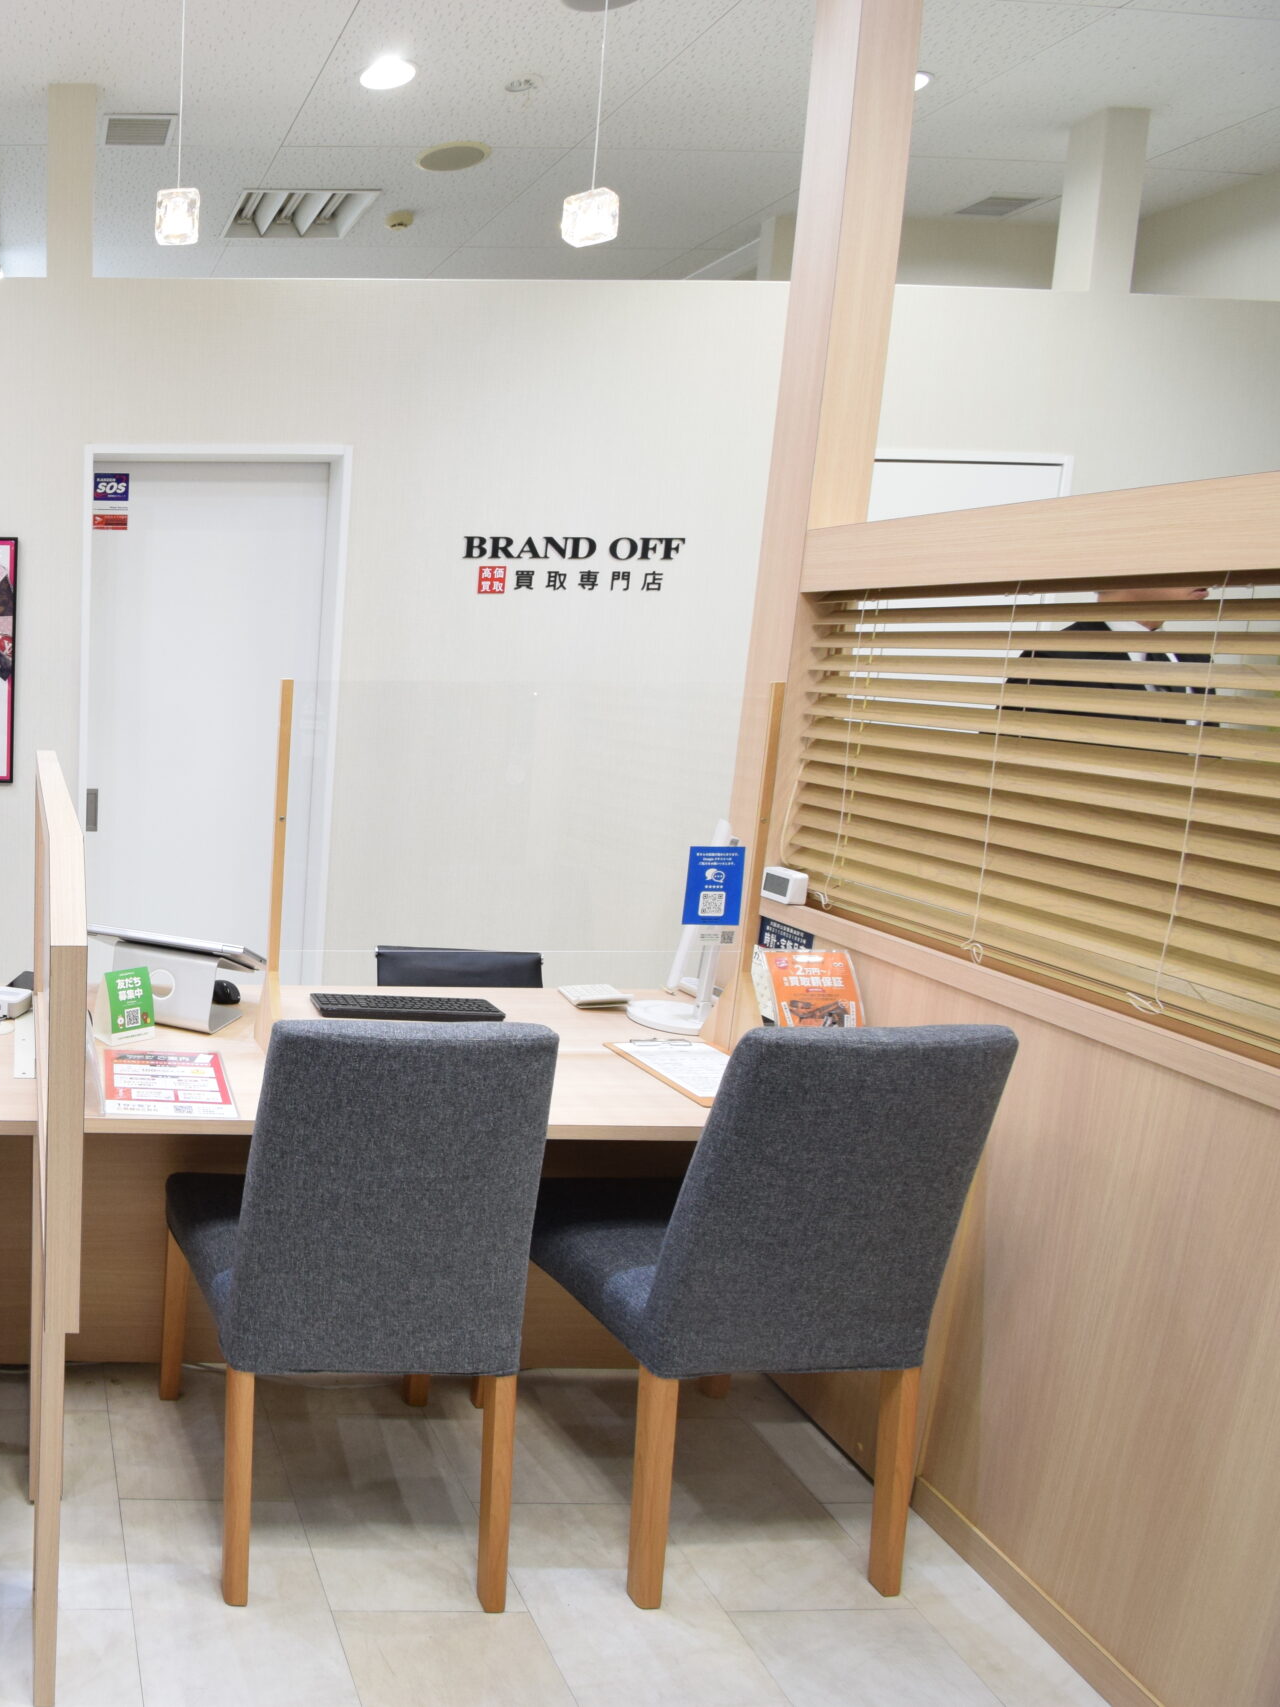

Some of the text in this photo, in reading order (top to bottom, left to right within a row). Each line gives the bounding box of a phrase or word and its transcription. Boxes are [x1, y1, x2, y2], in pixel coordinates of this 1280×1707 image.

[96, 482, 127, 493] SOS
[462, 536, 686, 561] BRAND OFF
[481, 567, 505, 579] 高価
[480, 581, 504, 592] 買取
[514, 570, 664, 591] 買取専門店
[116, 976, 141, 989] 友だち
